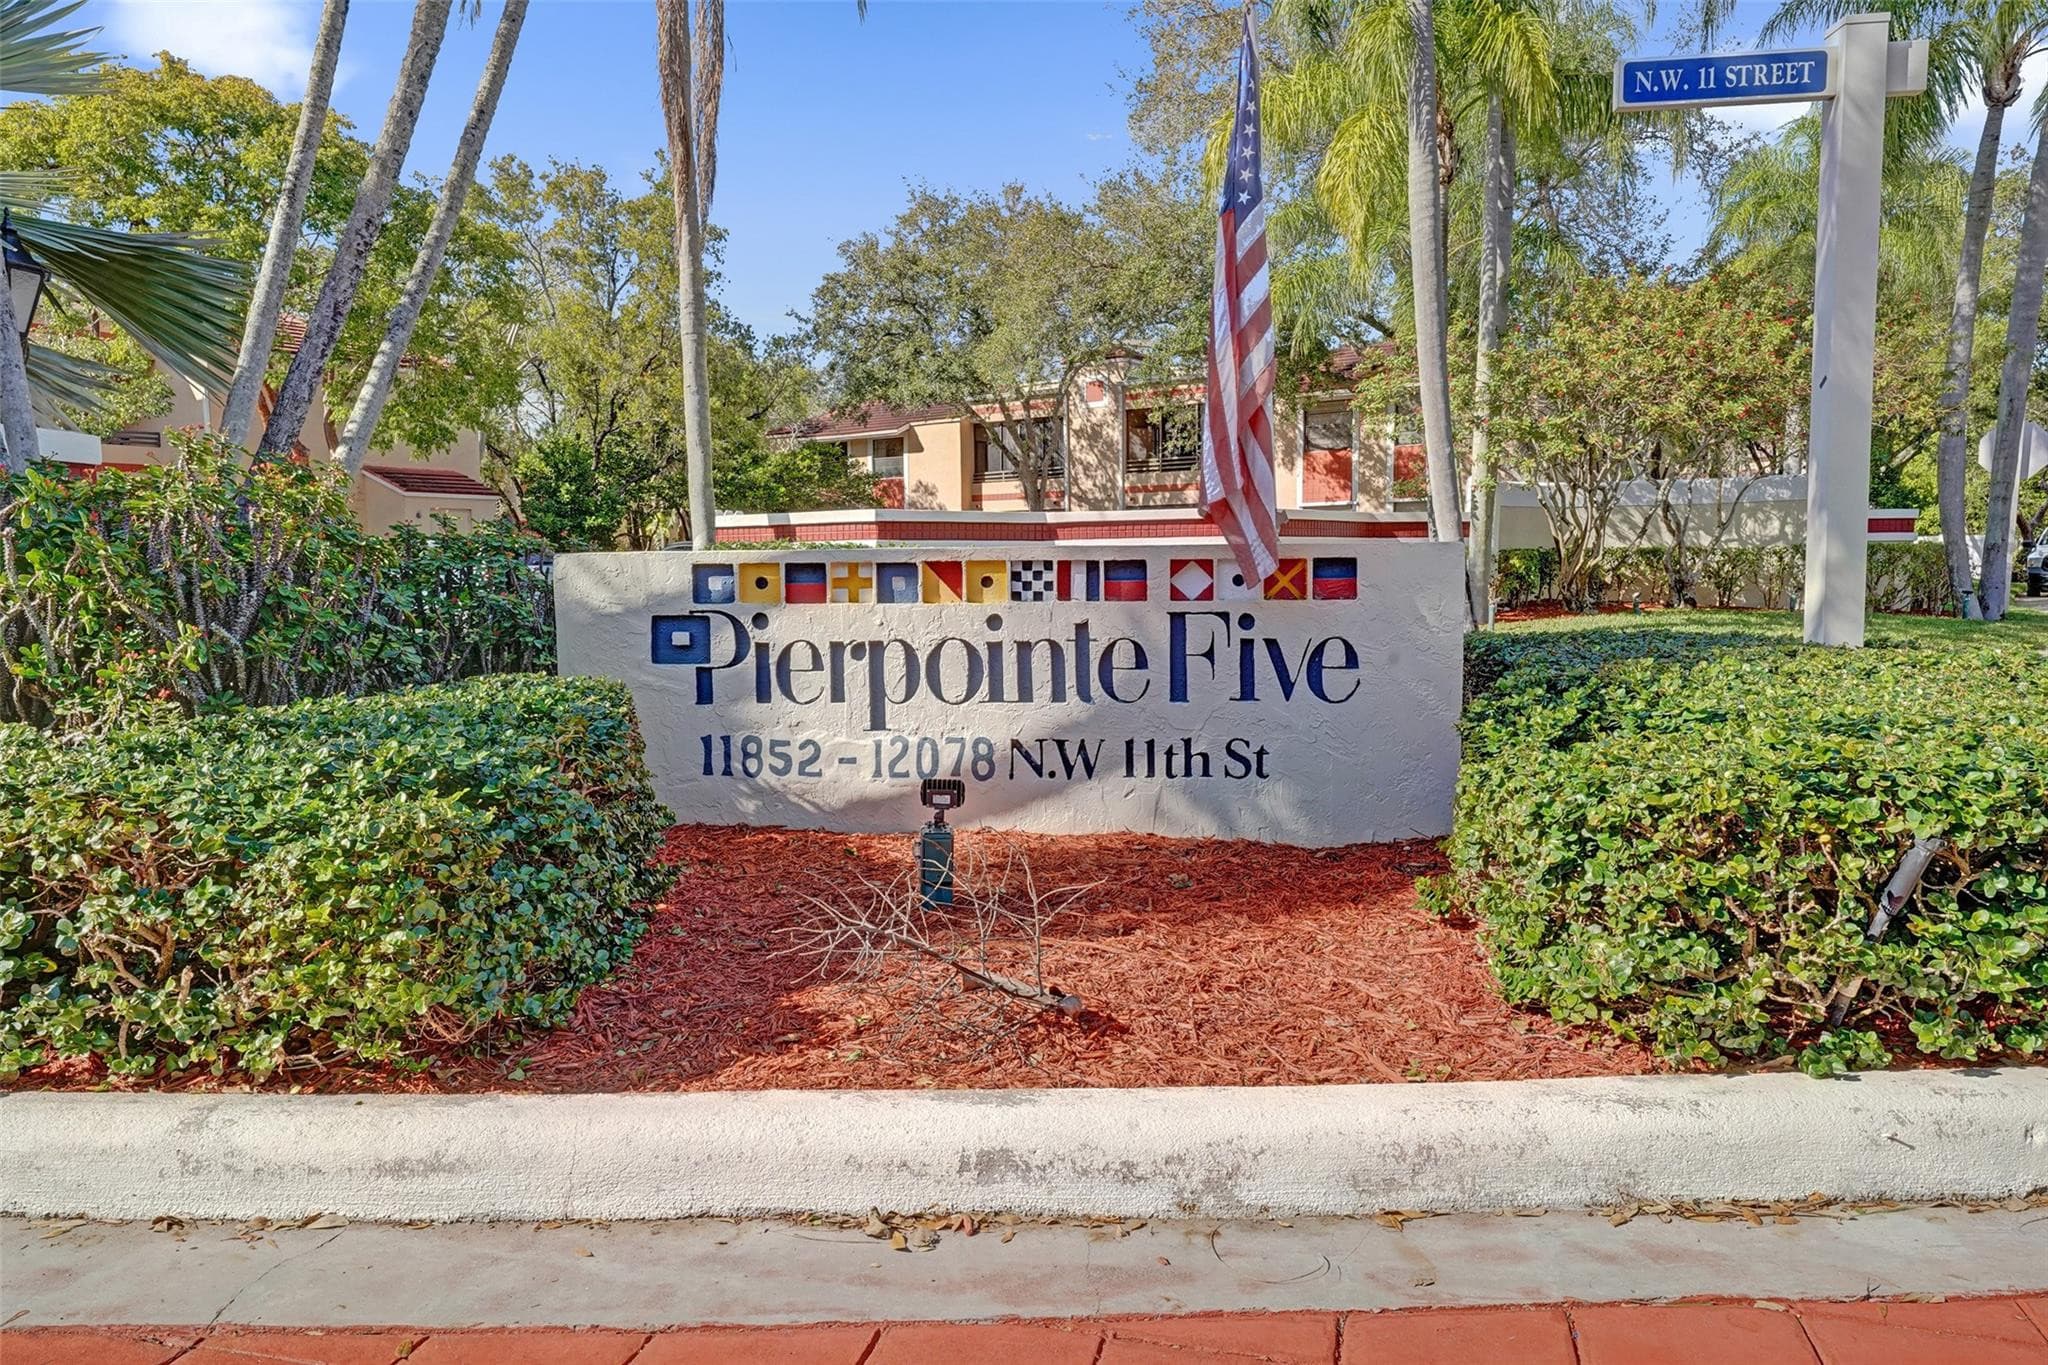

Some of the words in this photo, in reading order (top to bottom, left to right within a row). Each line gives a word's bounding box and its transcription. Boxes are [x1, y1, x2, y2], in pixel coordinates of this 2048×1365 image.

[1634, 68, 1689, 93] N.W.
[1697, 66, 1717, 89] 11
[1725, 61, 1815, 88] STREET
[688, 609, 1151, 731] Pierpointe
[1166, 611, 1361, 706] Five
[700, 734, 823, 779] 11852
[871, 736, 996, 781] 12078
[1009, 737, 1106, 781] N.W
[1123, 737, 1214, 780] 11th
[1224, 737, 1271, 780] St
